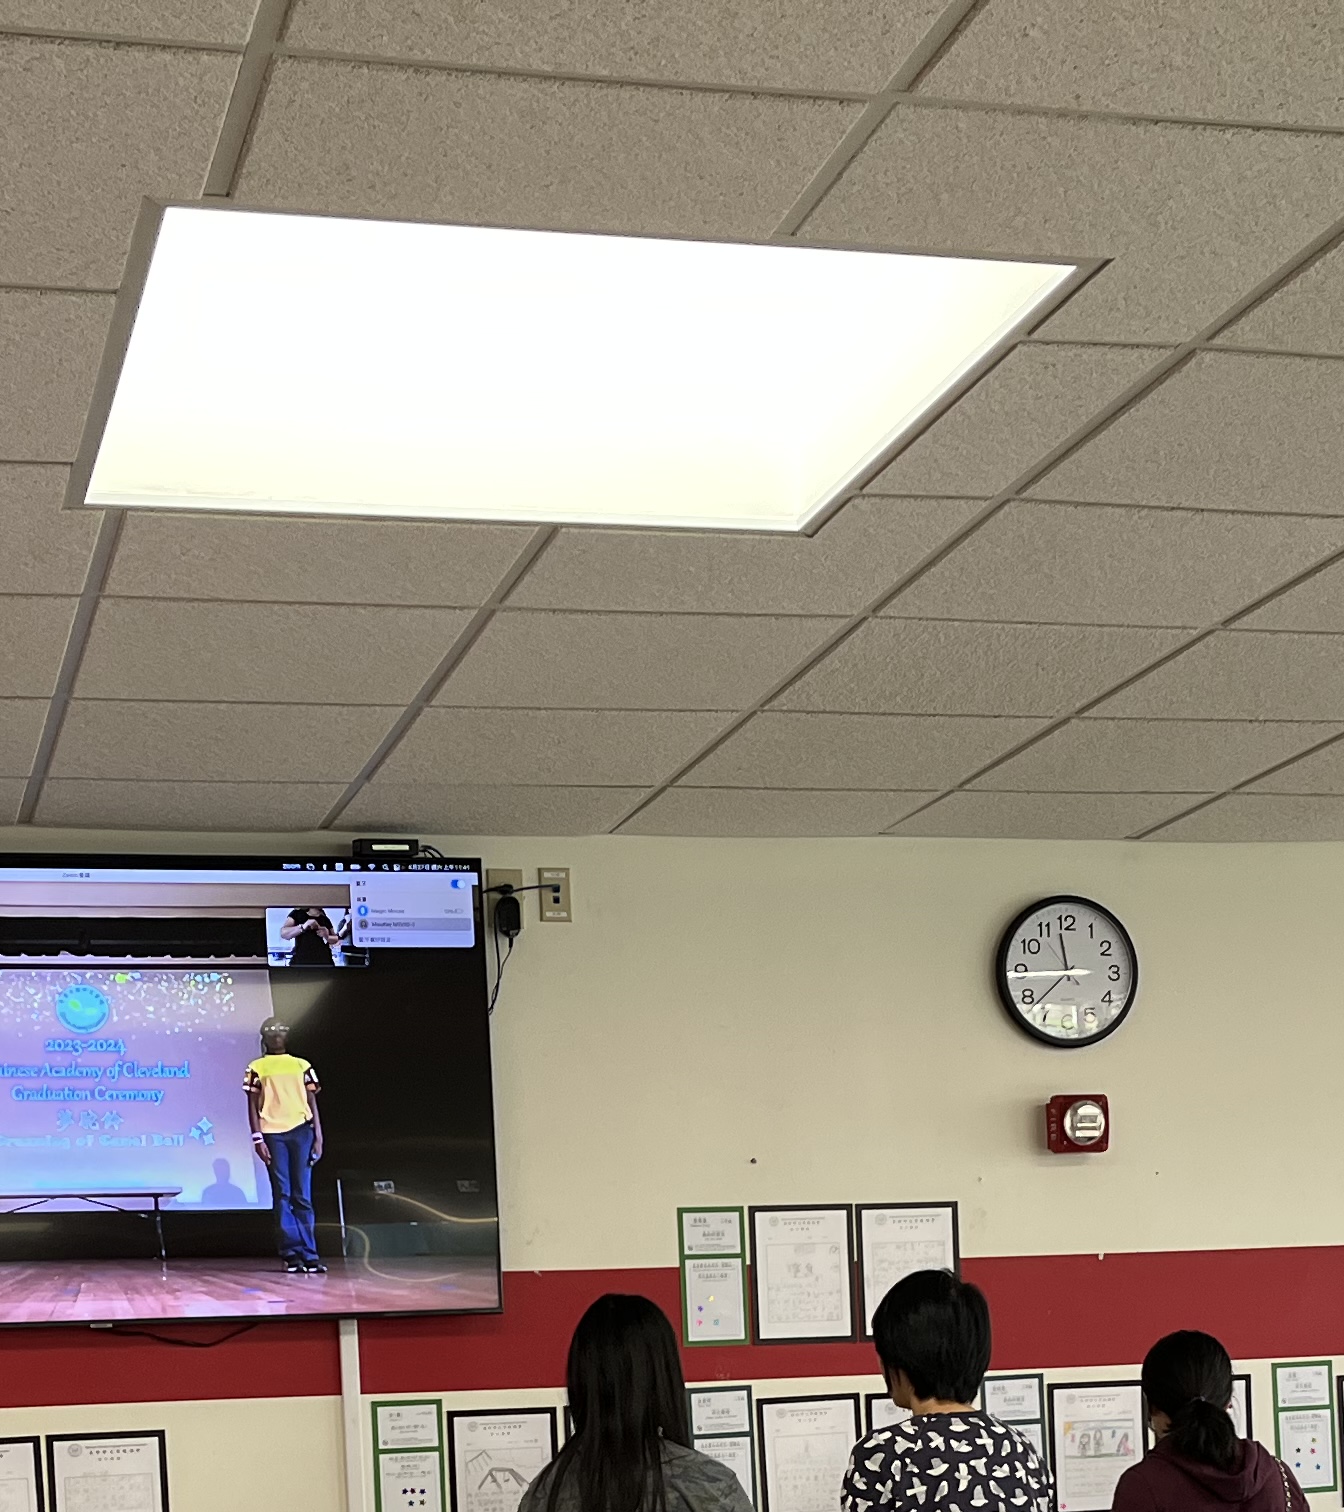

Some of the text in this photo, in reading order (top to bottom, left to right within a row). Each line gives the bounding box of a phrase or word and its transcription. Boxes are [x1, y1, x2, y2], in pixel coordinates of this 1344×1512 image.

[1037, 921, 1051, 938] 11
[1056, 914, 1077, 931] 12
[1020, 938, 1041, 955] 10
[1099, 940, 1112, 957] 2
[1014, 963, 1029, 979] 9
[1107, 964, 1121, 981] 3
[1021, 988, 1035, 1005] 8
[1101, 990, 1113, 1006] 4
[1083, 1007, 1096, 1023] 5
[45, 1038, 127, 1056] 2023-2024
[40, 1062, 103, 1082] Academy
[106, 1061, 123, 1082] of
[123, 1060, 191, 1079] Cleveland
[11, 1084, 165, 1106] Graduation Ceremony
